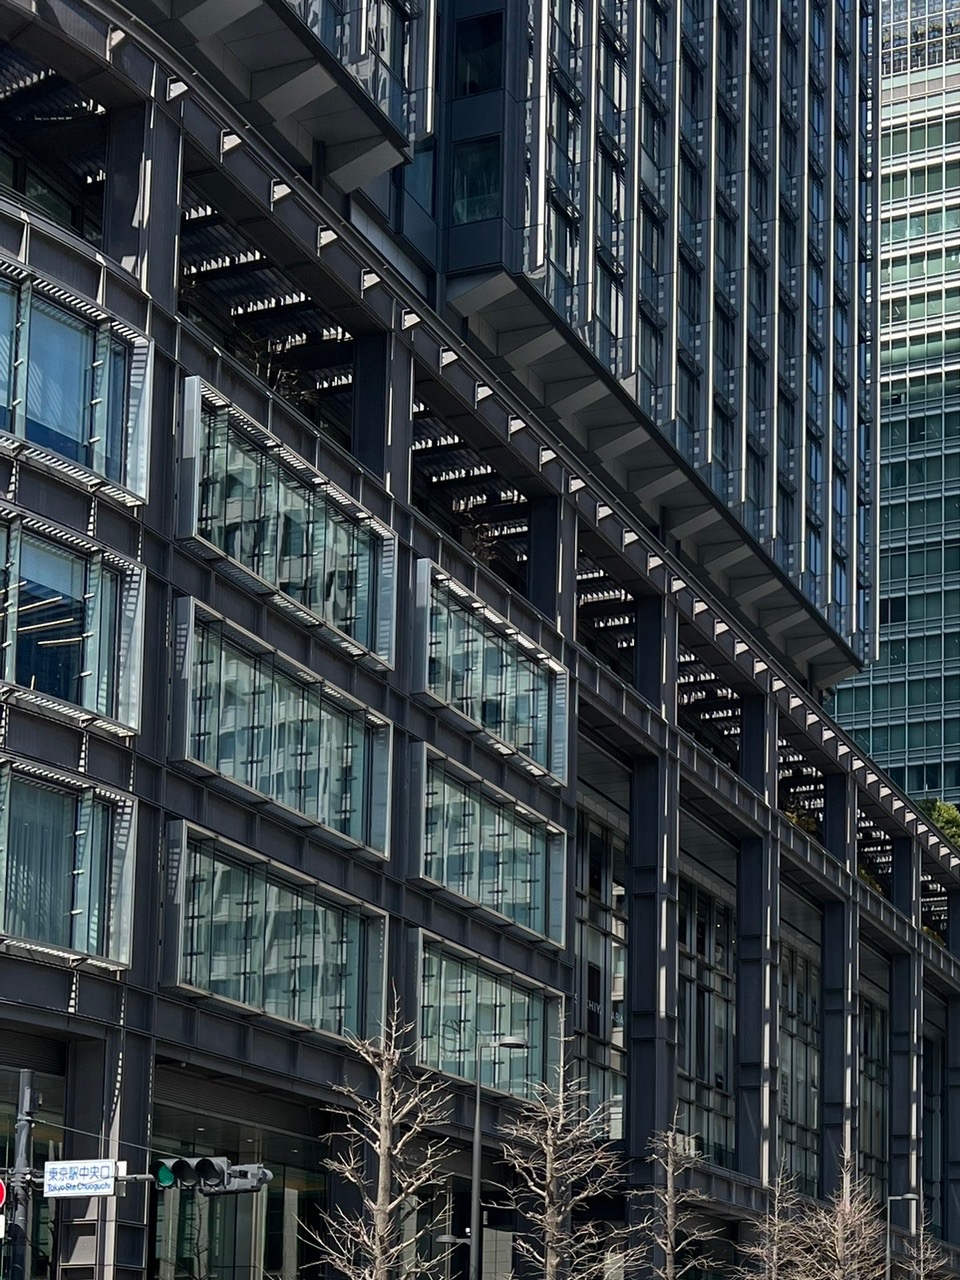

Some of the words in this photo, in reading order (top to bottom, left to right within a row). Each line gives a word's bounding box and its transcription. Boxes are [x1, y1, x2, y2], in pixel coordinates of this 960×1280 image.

[48, 1165, 110, 1181] 東京駅中央口
[47, 1183, 65, 1193] Tokyo
[76, 1181, 111, 1191] Chuoguchi
